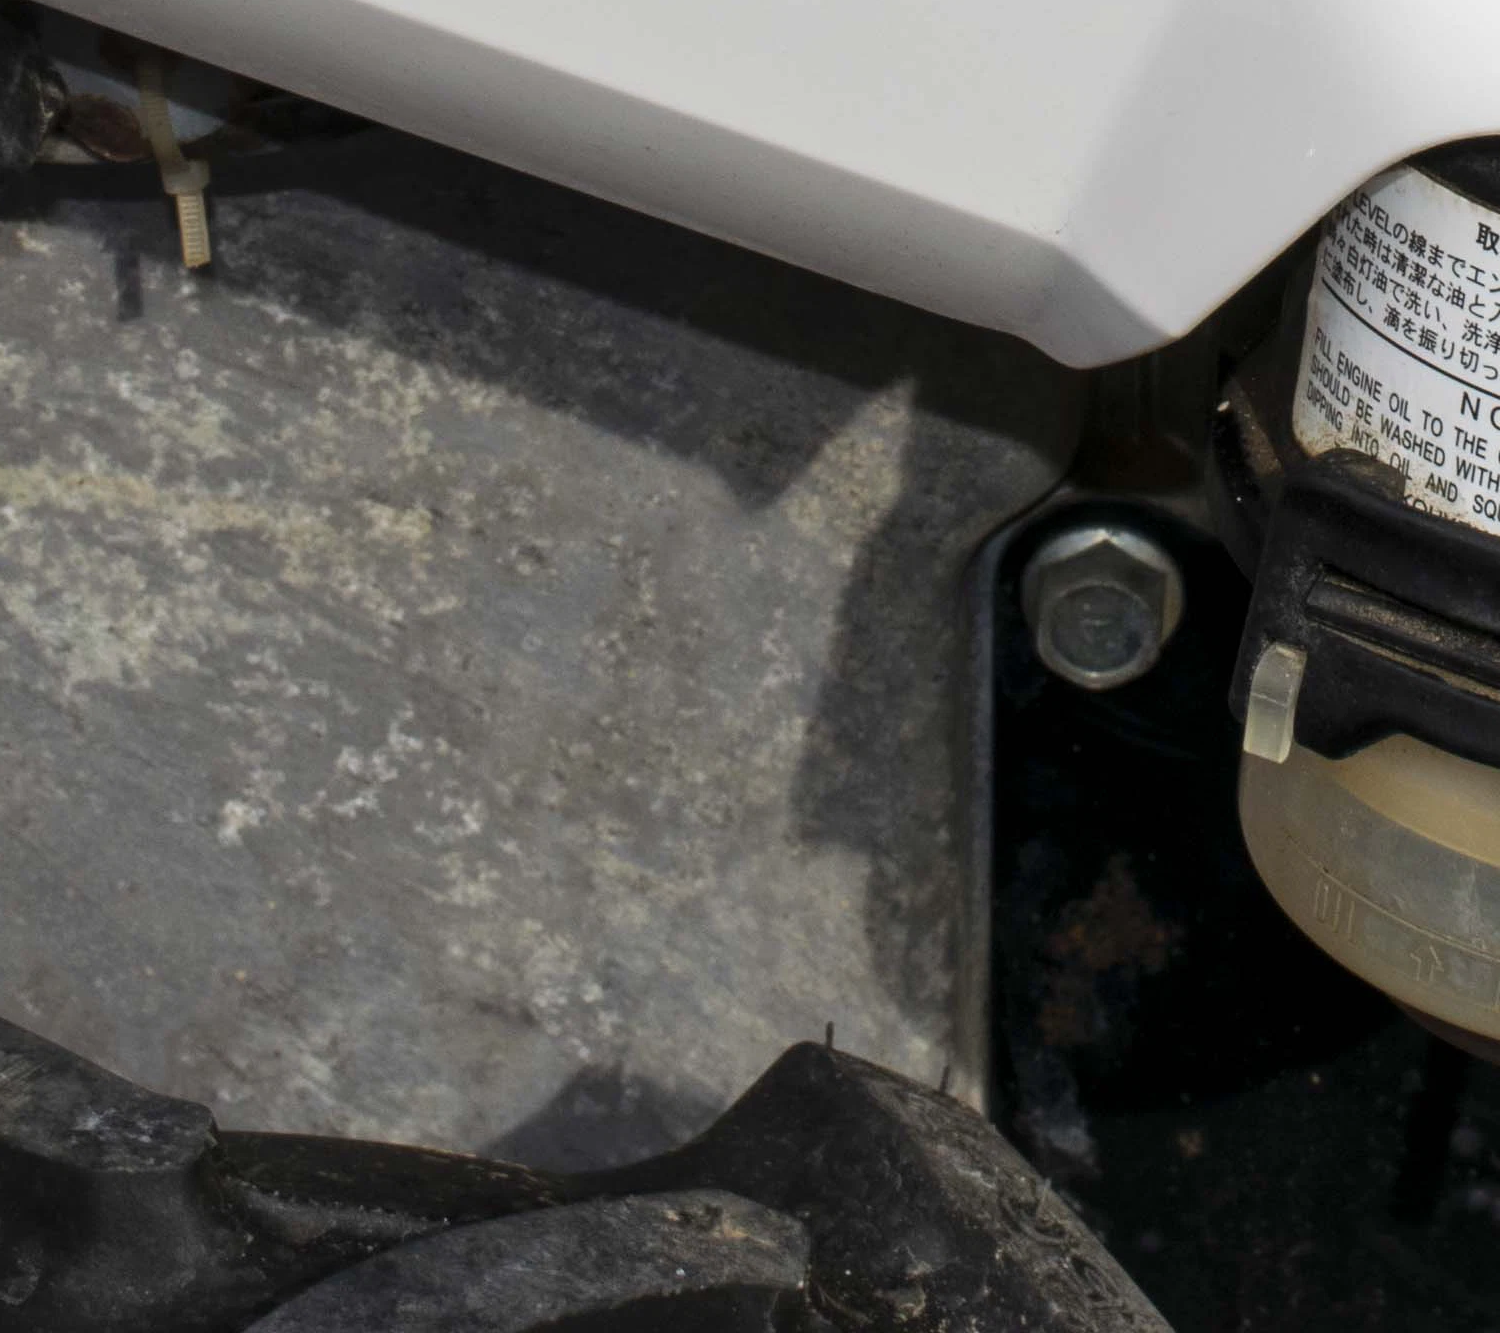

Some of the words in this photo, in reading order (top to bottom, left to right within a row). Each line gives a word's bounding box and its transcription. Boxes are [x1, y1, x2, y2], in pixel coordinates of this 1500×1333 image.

[1306, 380, 1343, 433] DIPPING
[1351, 424, 1379, 459] INTO
[1389, 452, 1412, 481] OIL
[1425, 473, 1458, 503] AND
[1310, 355, 1350, 407] SHOULD
[1355, 398, 1373, 425] BE
[1380, 414, 1445, 467] WASHED
[1455, 456, 1500, 493] WITH
[1315, 327, 1333, 363] FILL
[1337, 351, 1382, 402] ENGINE
[1389, 393, 1411, 422] OIL
[1422, 410, 1443, 437] TO
[1454, 427, 1487, 459] THE
